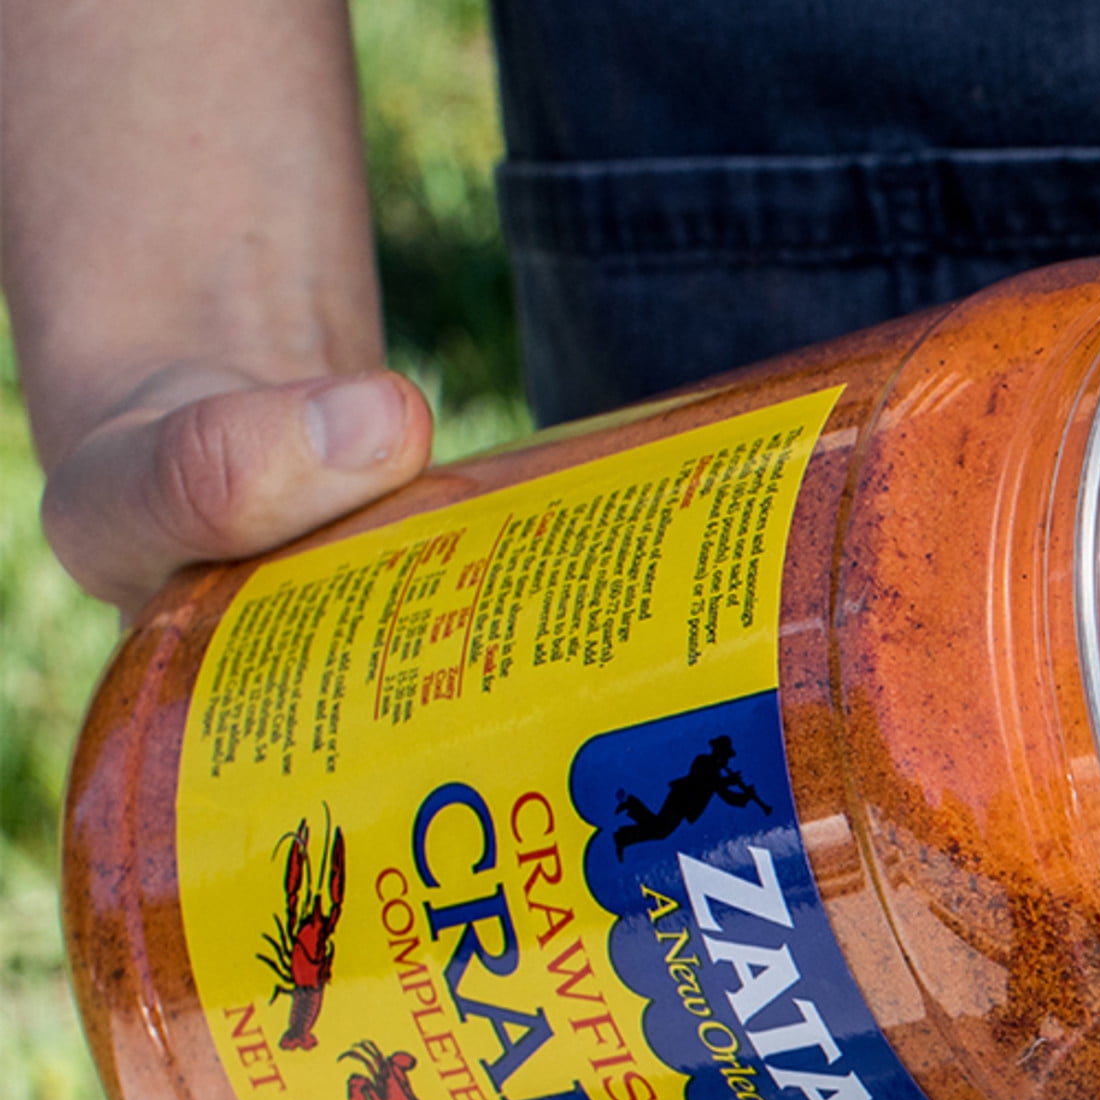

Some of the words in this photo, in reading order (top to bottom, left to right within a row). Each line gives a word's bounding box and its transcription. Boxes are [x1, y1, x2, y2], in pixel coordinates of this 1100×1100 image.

[640, 884, 681, 922] A
[656, 928, 713, 1019] New
[224, 1003, 287, 1092] NET
